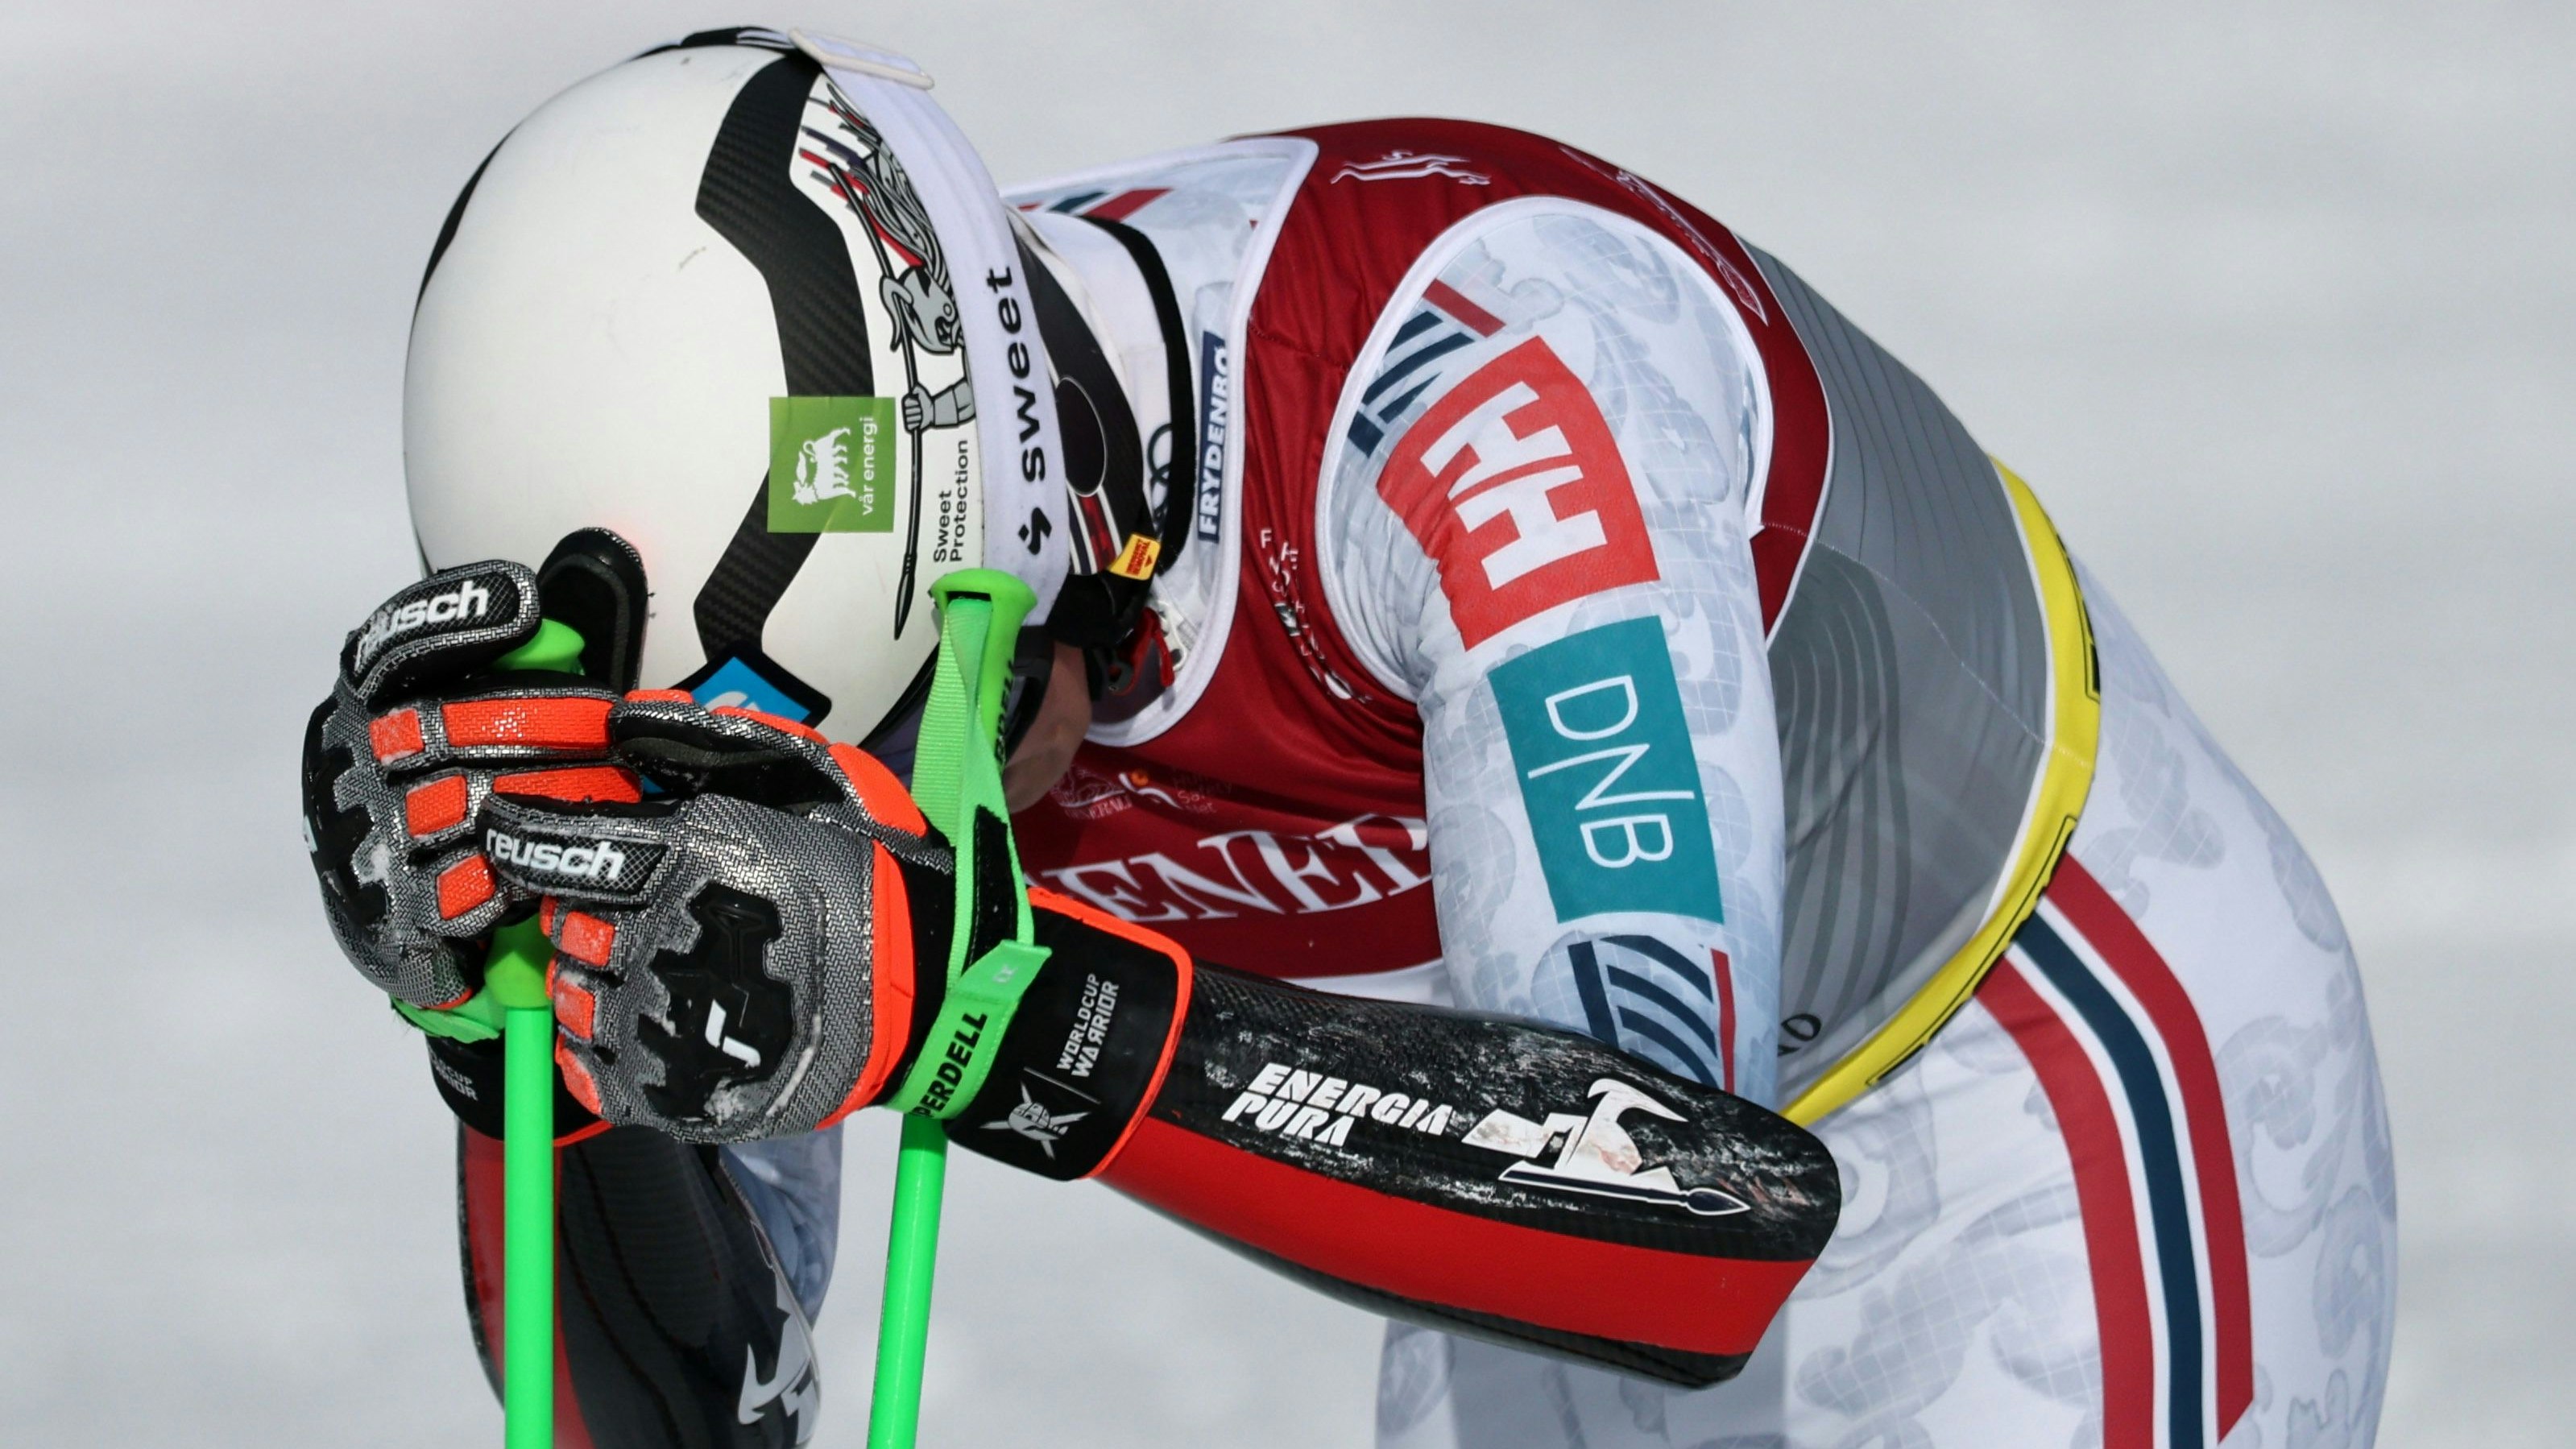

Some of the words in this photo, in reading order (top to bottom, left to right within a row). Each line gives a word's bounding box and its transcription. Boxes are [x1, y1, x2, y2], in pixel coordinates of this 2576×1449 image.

[986, 266, 1046, 483] sweet
[859, 416, 878, 481] energi
[859, 485, 874, 516] vår
[933, 490, 952, 564] Sweet
[949, 440, 969, 562] Protection
[1527, 674, 1696, 869] DNB
[486, 828, 626, 880] reusch
[1220, 1091, 1356, 1148] PURA
[1247, 1062, 1453, 1136] ENERGIA
